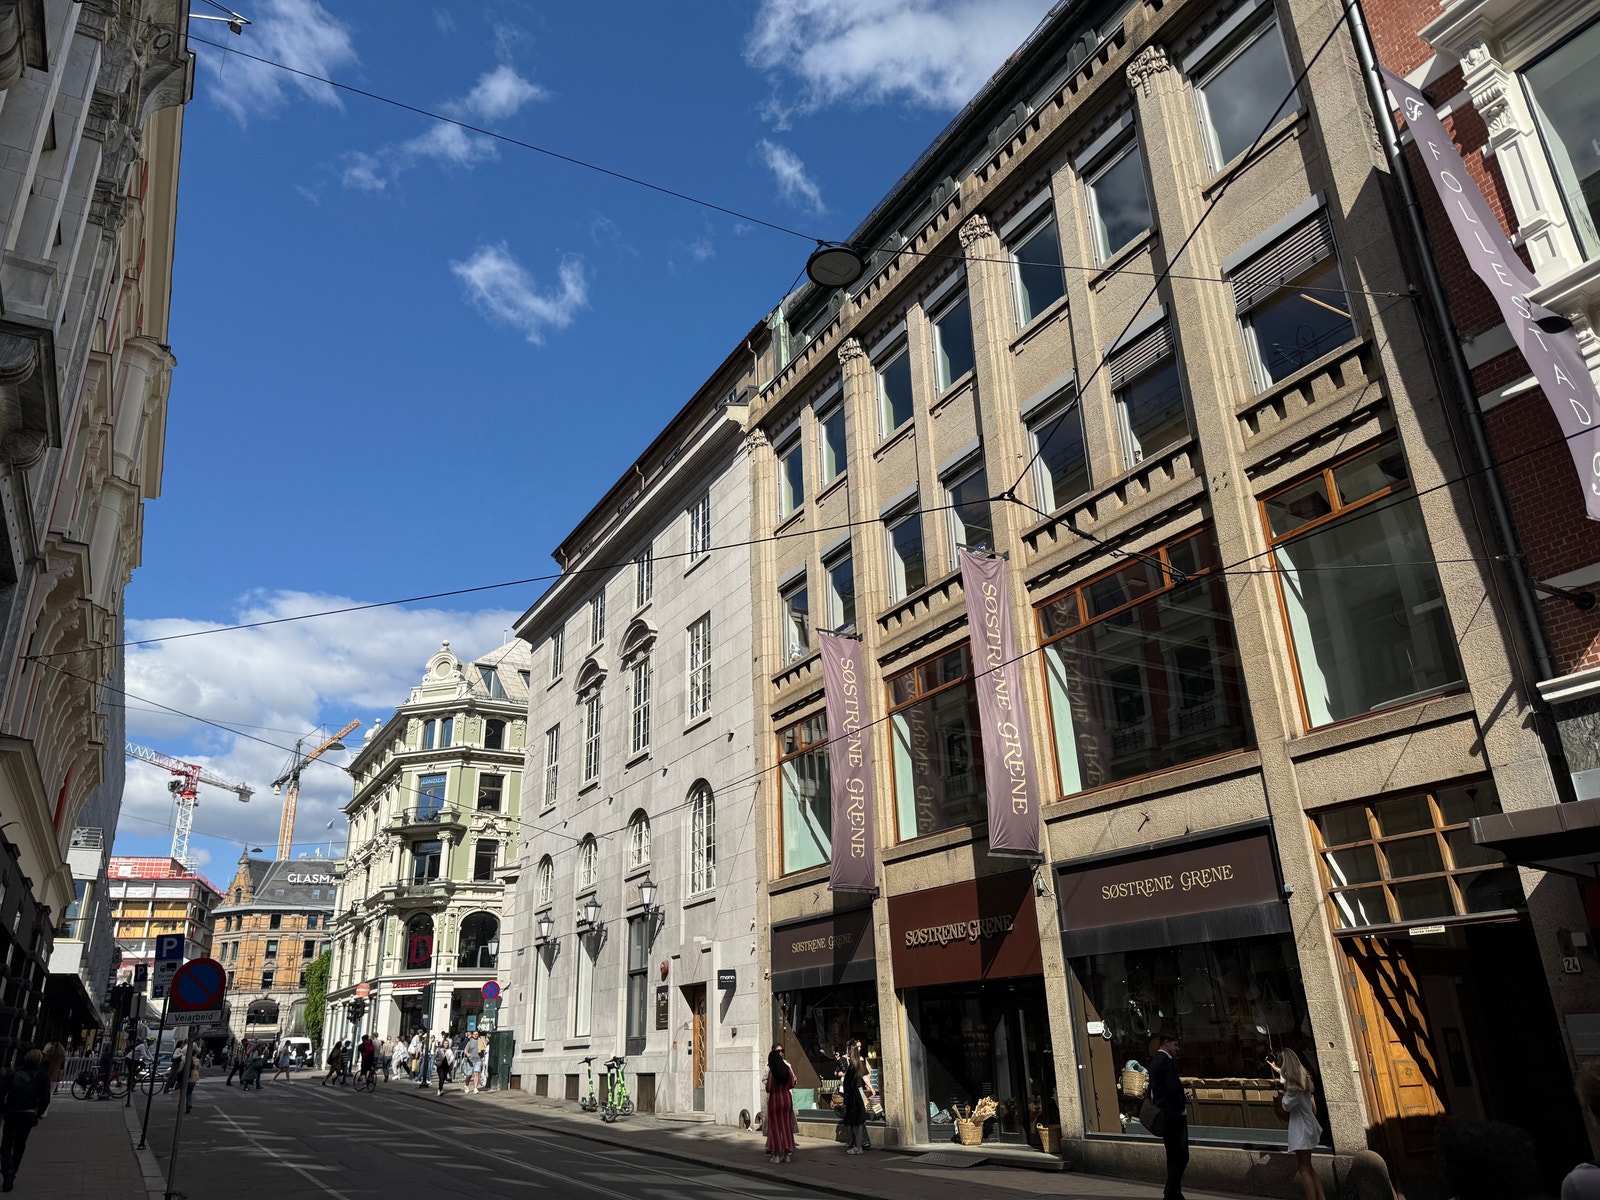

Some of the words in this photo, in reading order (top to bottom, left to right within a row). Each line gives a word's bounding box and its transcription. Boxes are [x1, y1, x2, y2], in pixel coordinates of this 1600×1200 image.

[1428, 141, 1591, 425] FOLLESTAD
[841, 657, 863, 768] SØSTRENE
[981, 582, 1012, 711] SØSTRENE
[997, 722, 1028, 816] GRENE
[845, 778, 865, 858] GRENE
[1101, 875, 1175, 900] SØSTRENE
[1180, 864, 1234, 891] GRENE
[791, 937, 826, 953] SØSTRENE
[828, 932, 853, 949] GRENE
[904, 922, 967, 947] SØSTRENE
[966, 914, 1014, 941] GRENE
[162, 937, 179, 958] P
[408, 935, 433, 963] D
[137, 965, 145, 980] P
[1564, 958, 1579, 972] 24
[174, 1013, 214, 1023] Veiarbeid
